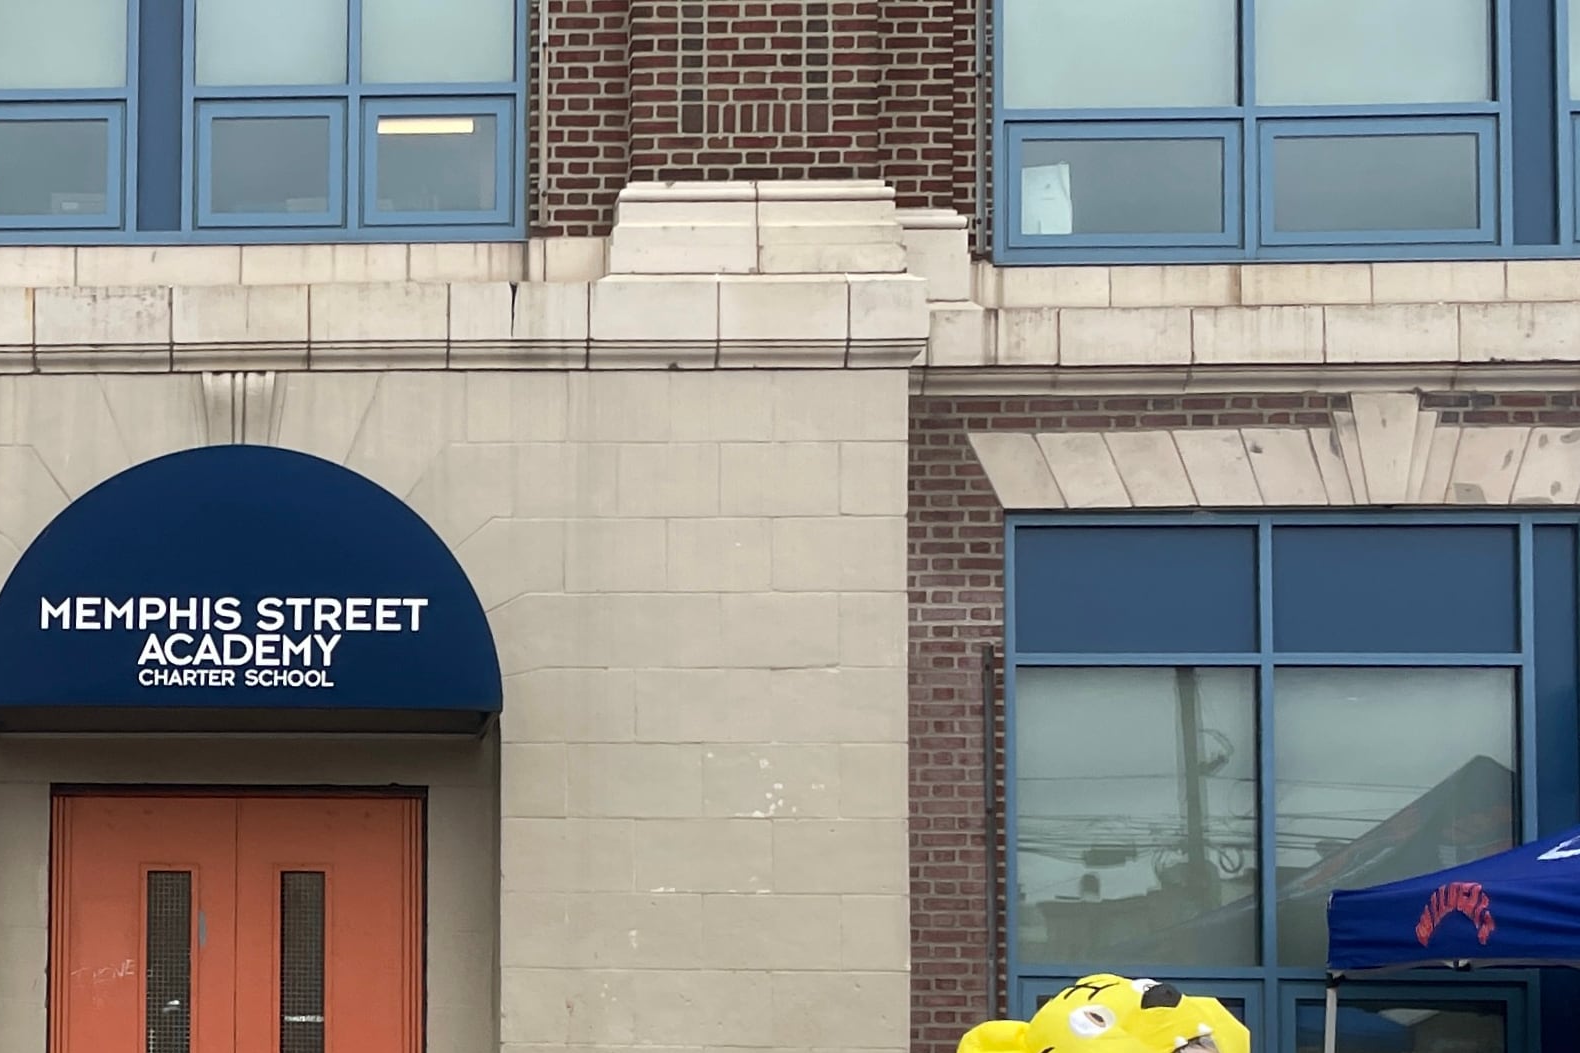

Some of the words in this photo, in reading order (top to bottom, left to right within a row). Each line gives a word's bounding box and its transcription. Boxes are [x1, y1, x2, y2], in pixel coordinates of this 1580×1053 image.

[40, 596, 242, 631] MEMPHIS
[256, 597, 429, 632] STREET
[137, 633, 342, 667] ACADEMY
[138, 668, 236, 687] CHARTER
[244, 668, 335, 688] SCHOOL
